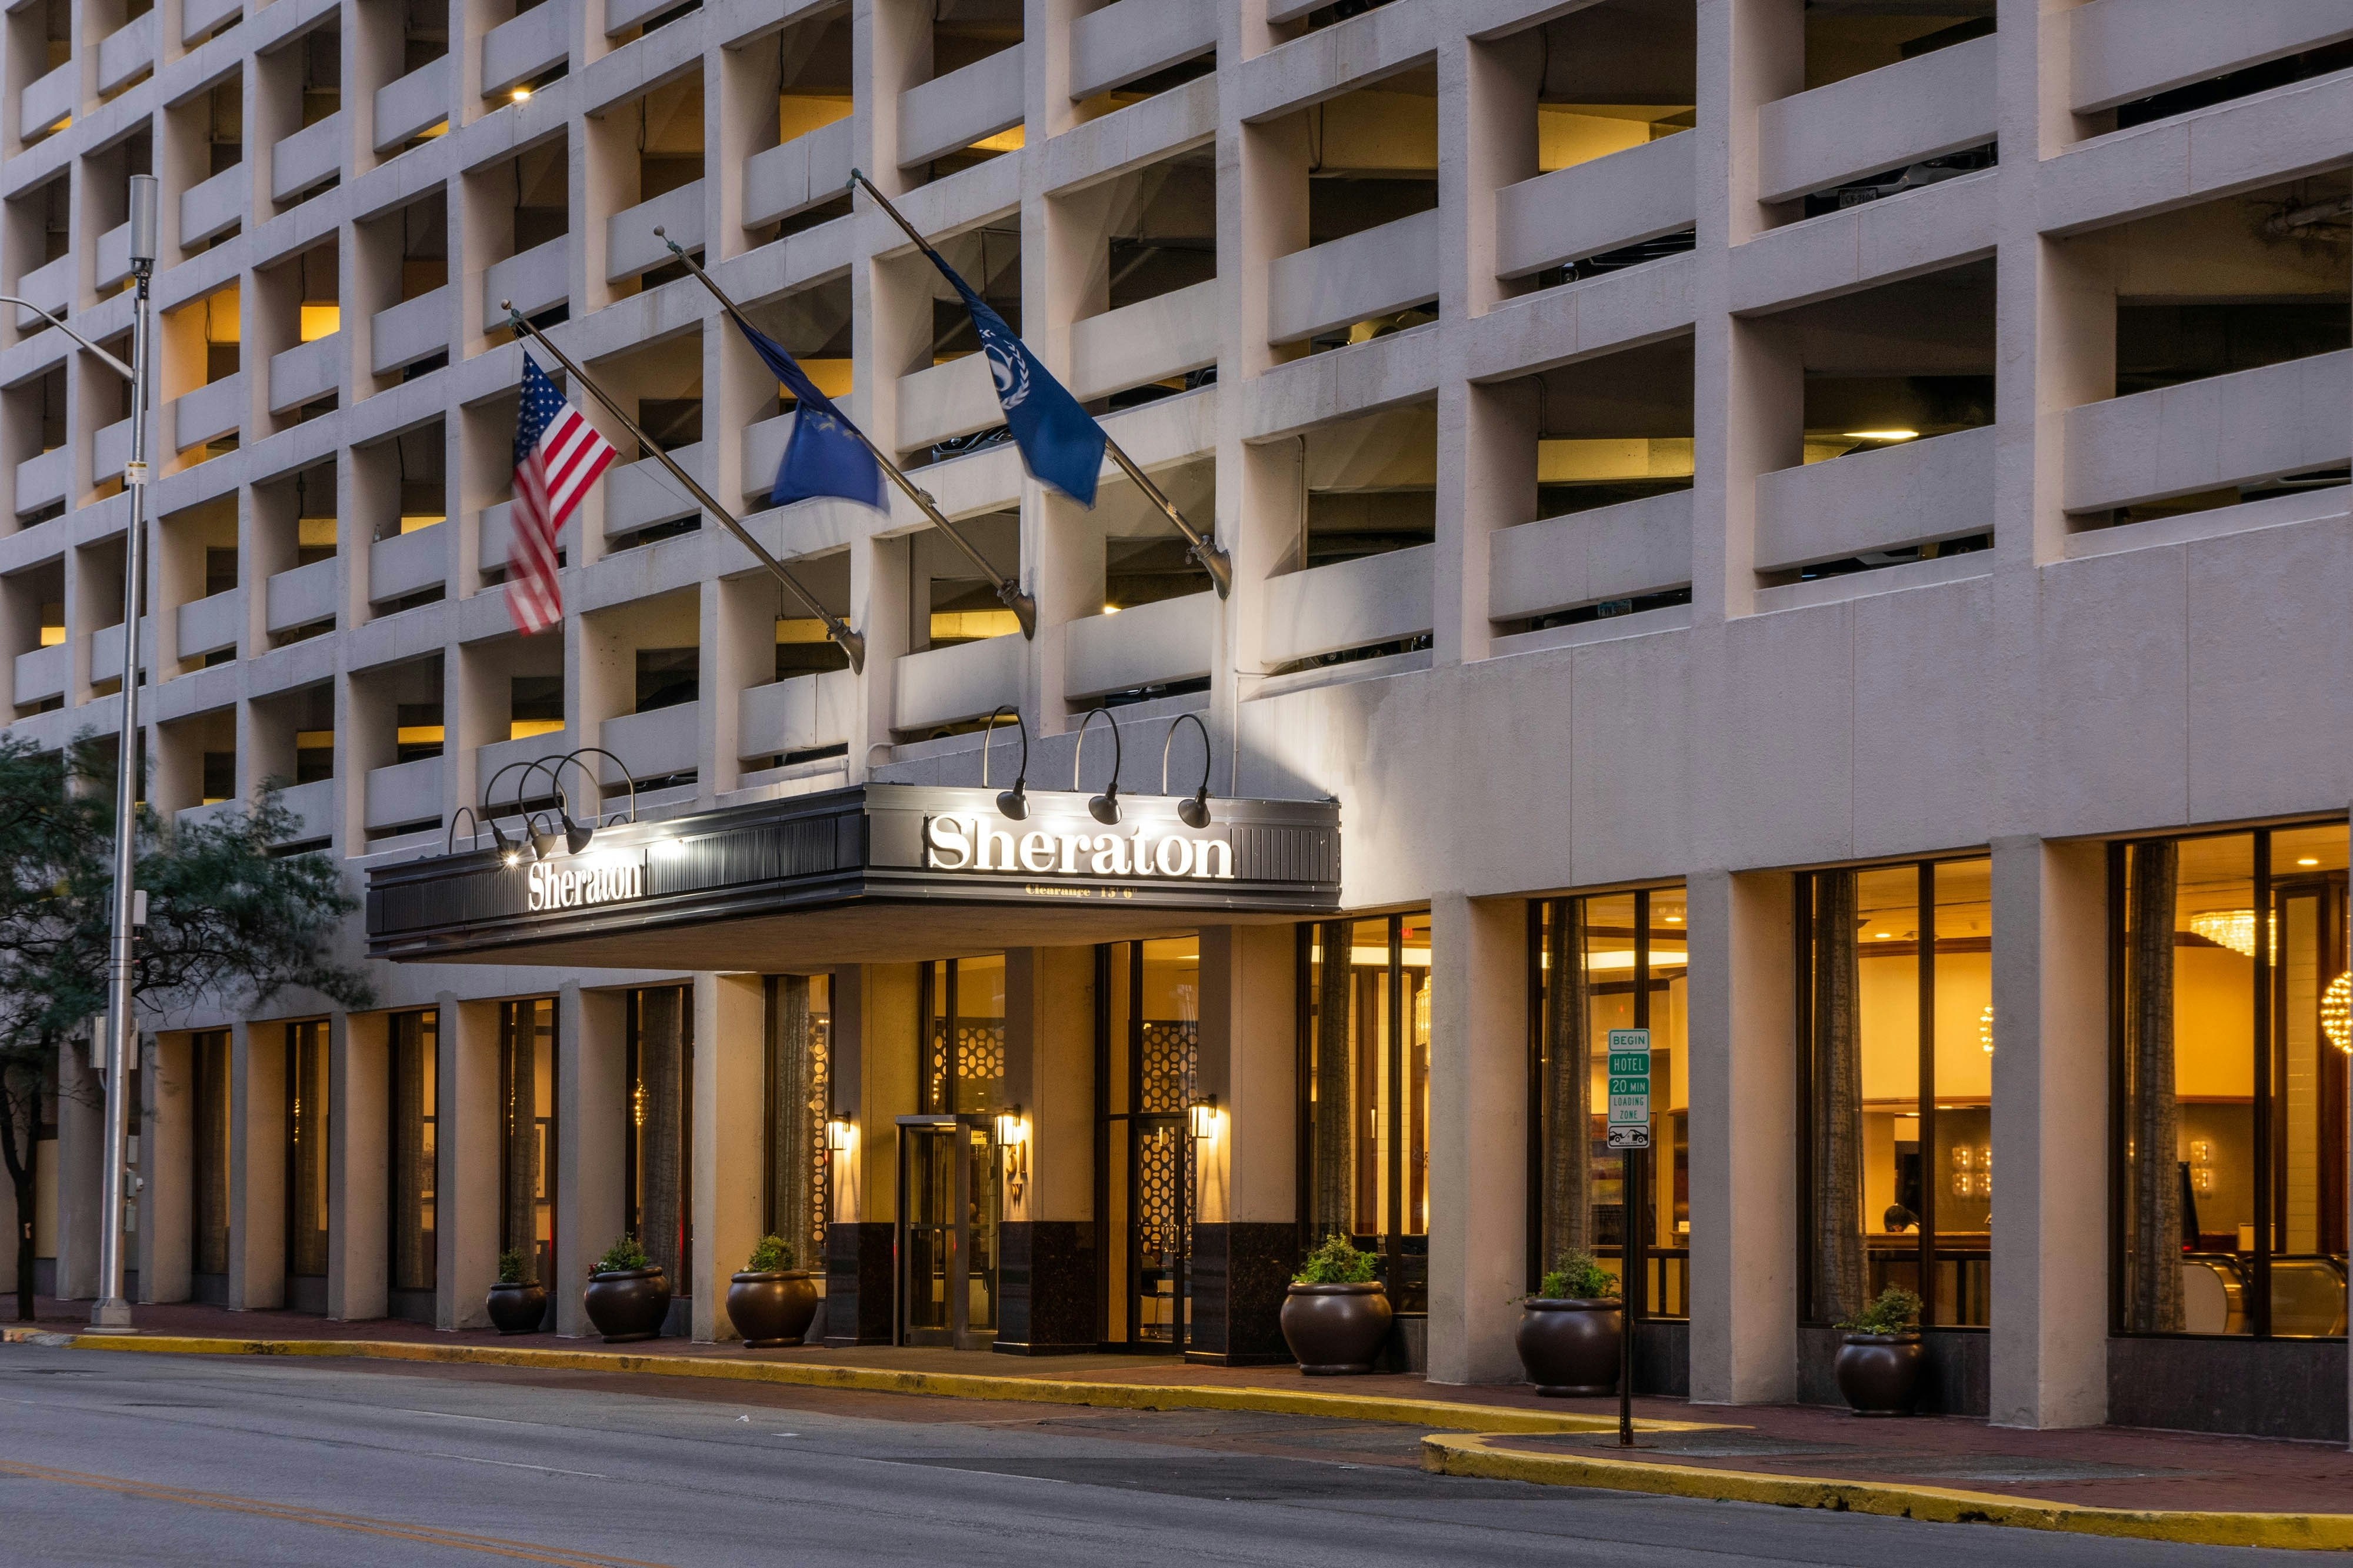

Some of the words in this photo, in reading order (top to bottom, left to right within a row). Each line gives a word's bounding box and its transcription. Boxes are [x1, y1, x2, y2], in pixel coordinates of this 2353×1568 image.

[929, 813, 1235, 879] Sheraton
[529, 861, 642, 911] Sheraton
[1025, 884, 1091, 897] Clearance
[1614, 1036, 1645, 1045] BEGIN
[1614, 1058, 1644, 1071] HOTEL
[1612, 1080, 1627, 1093] 20
[1630, 1082, 1645, 1092] MIN
[1614, 1097, 1644, 1106] LOADING
[1619, 1110, 1638, 1119] ZONE
[1006, 1140, 1027, 1175] 31
[1011, 1183, 1024, 1199] W
